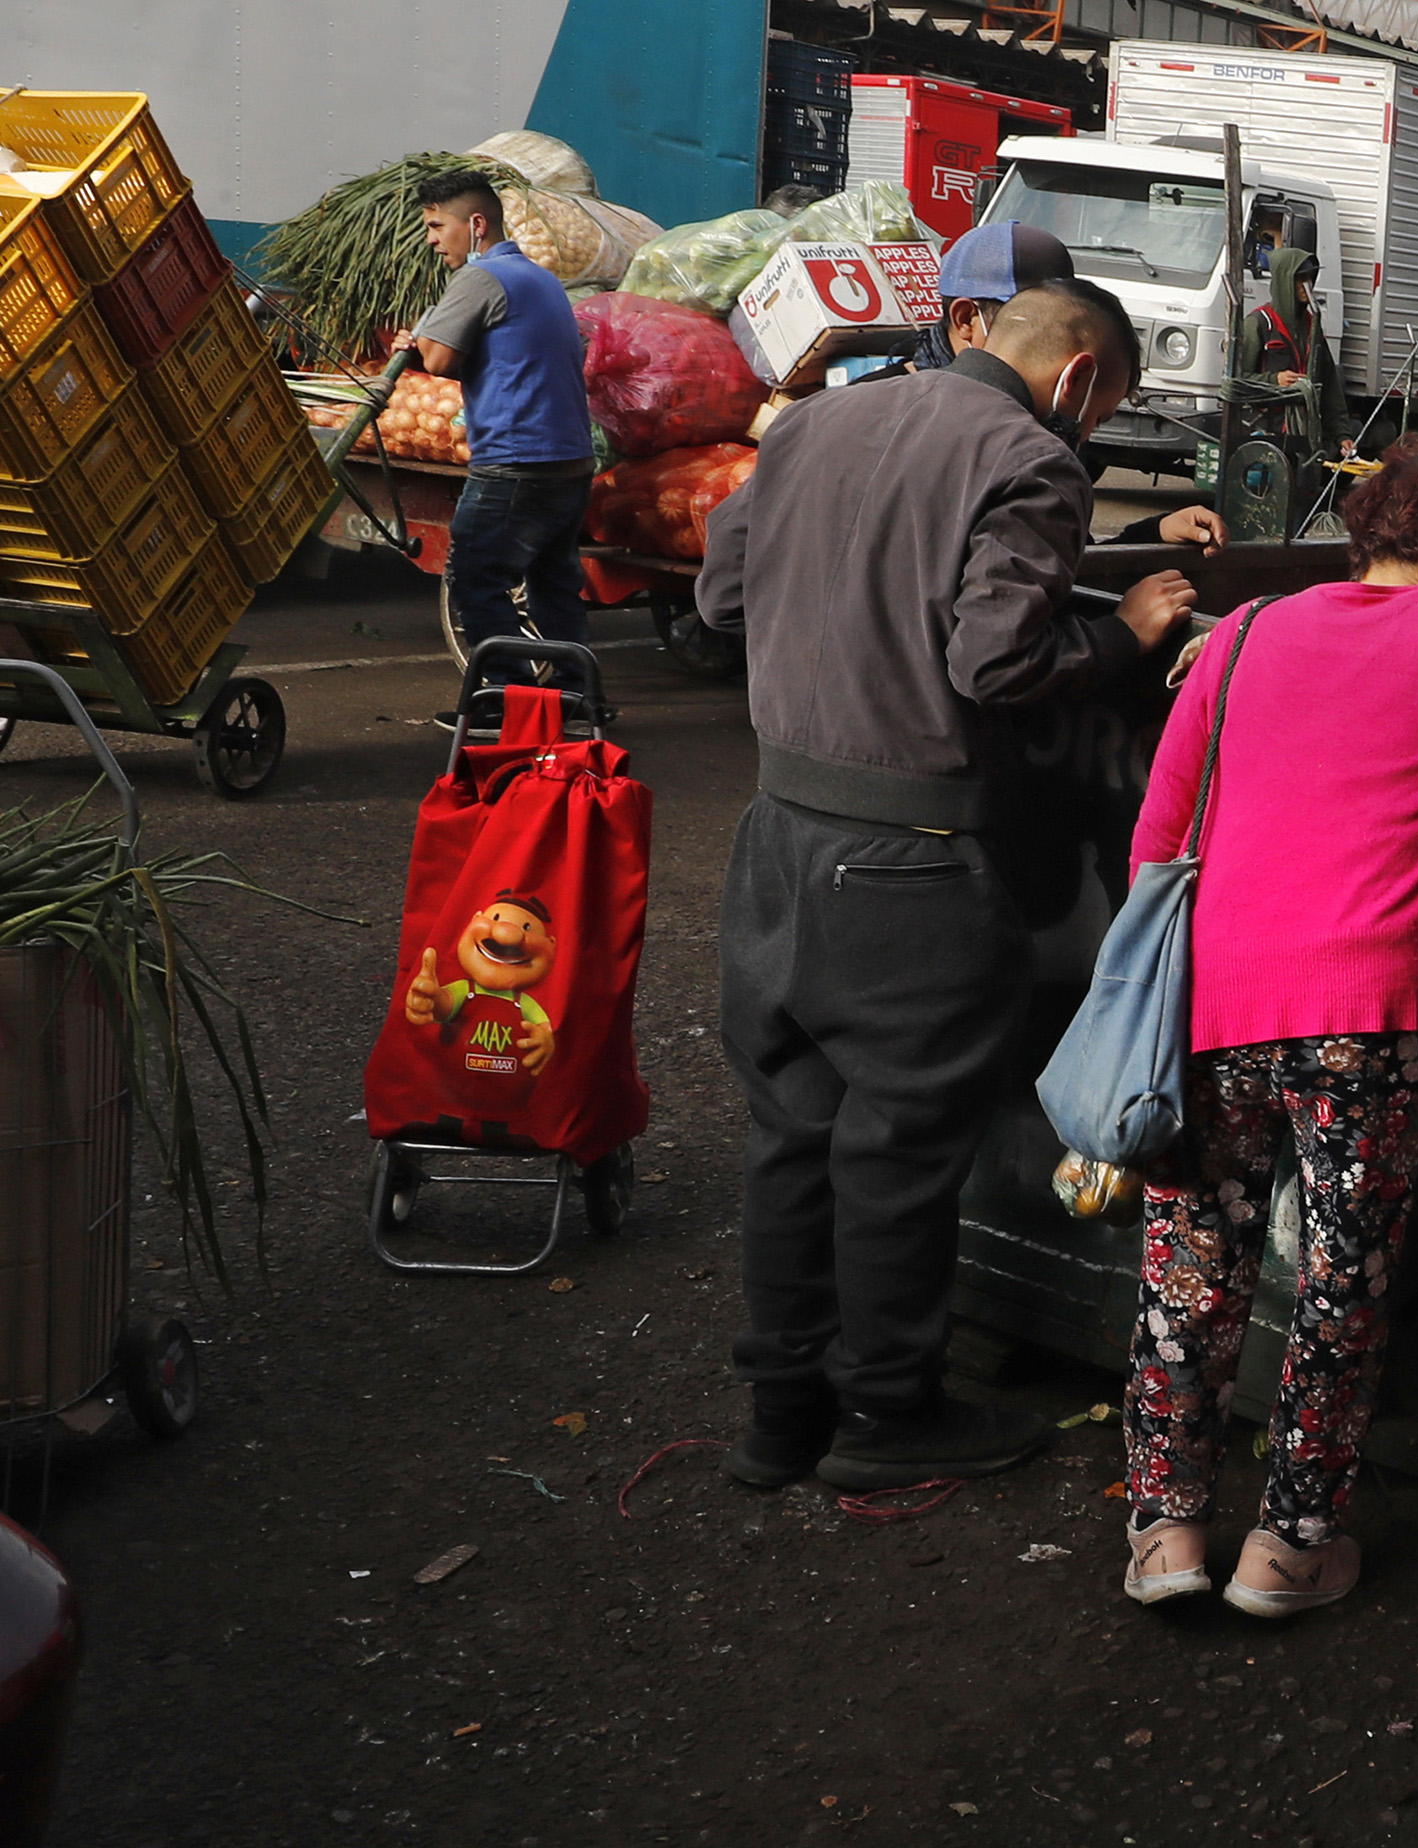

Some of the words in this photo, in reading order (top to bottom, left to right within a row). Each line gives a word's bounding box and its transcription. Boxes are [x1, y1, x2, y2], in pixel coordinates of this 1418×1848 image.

[1213, 63, 1285, 81] BENFOR
[934, 139, 982, 169] GT
[798, 244, 861, 259] unifrutti
[874, 246, 931, 260] APPLES
[882, 260, 938, 274] APPLES
[755, 255, 791, 302] unifrutti
[890, 274, 941, 288] APLES
[897, 289, 943, 303] APPLE
[470, 1020, 512, 1053] MAX
[469, 1058, 513, 1070] SURTIMAX
